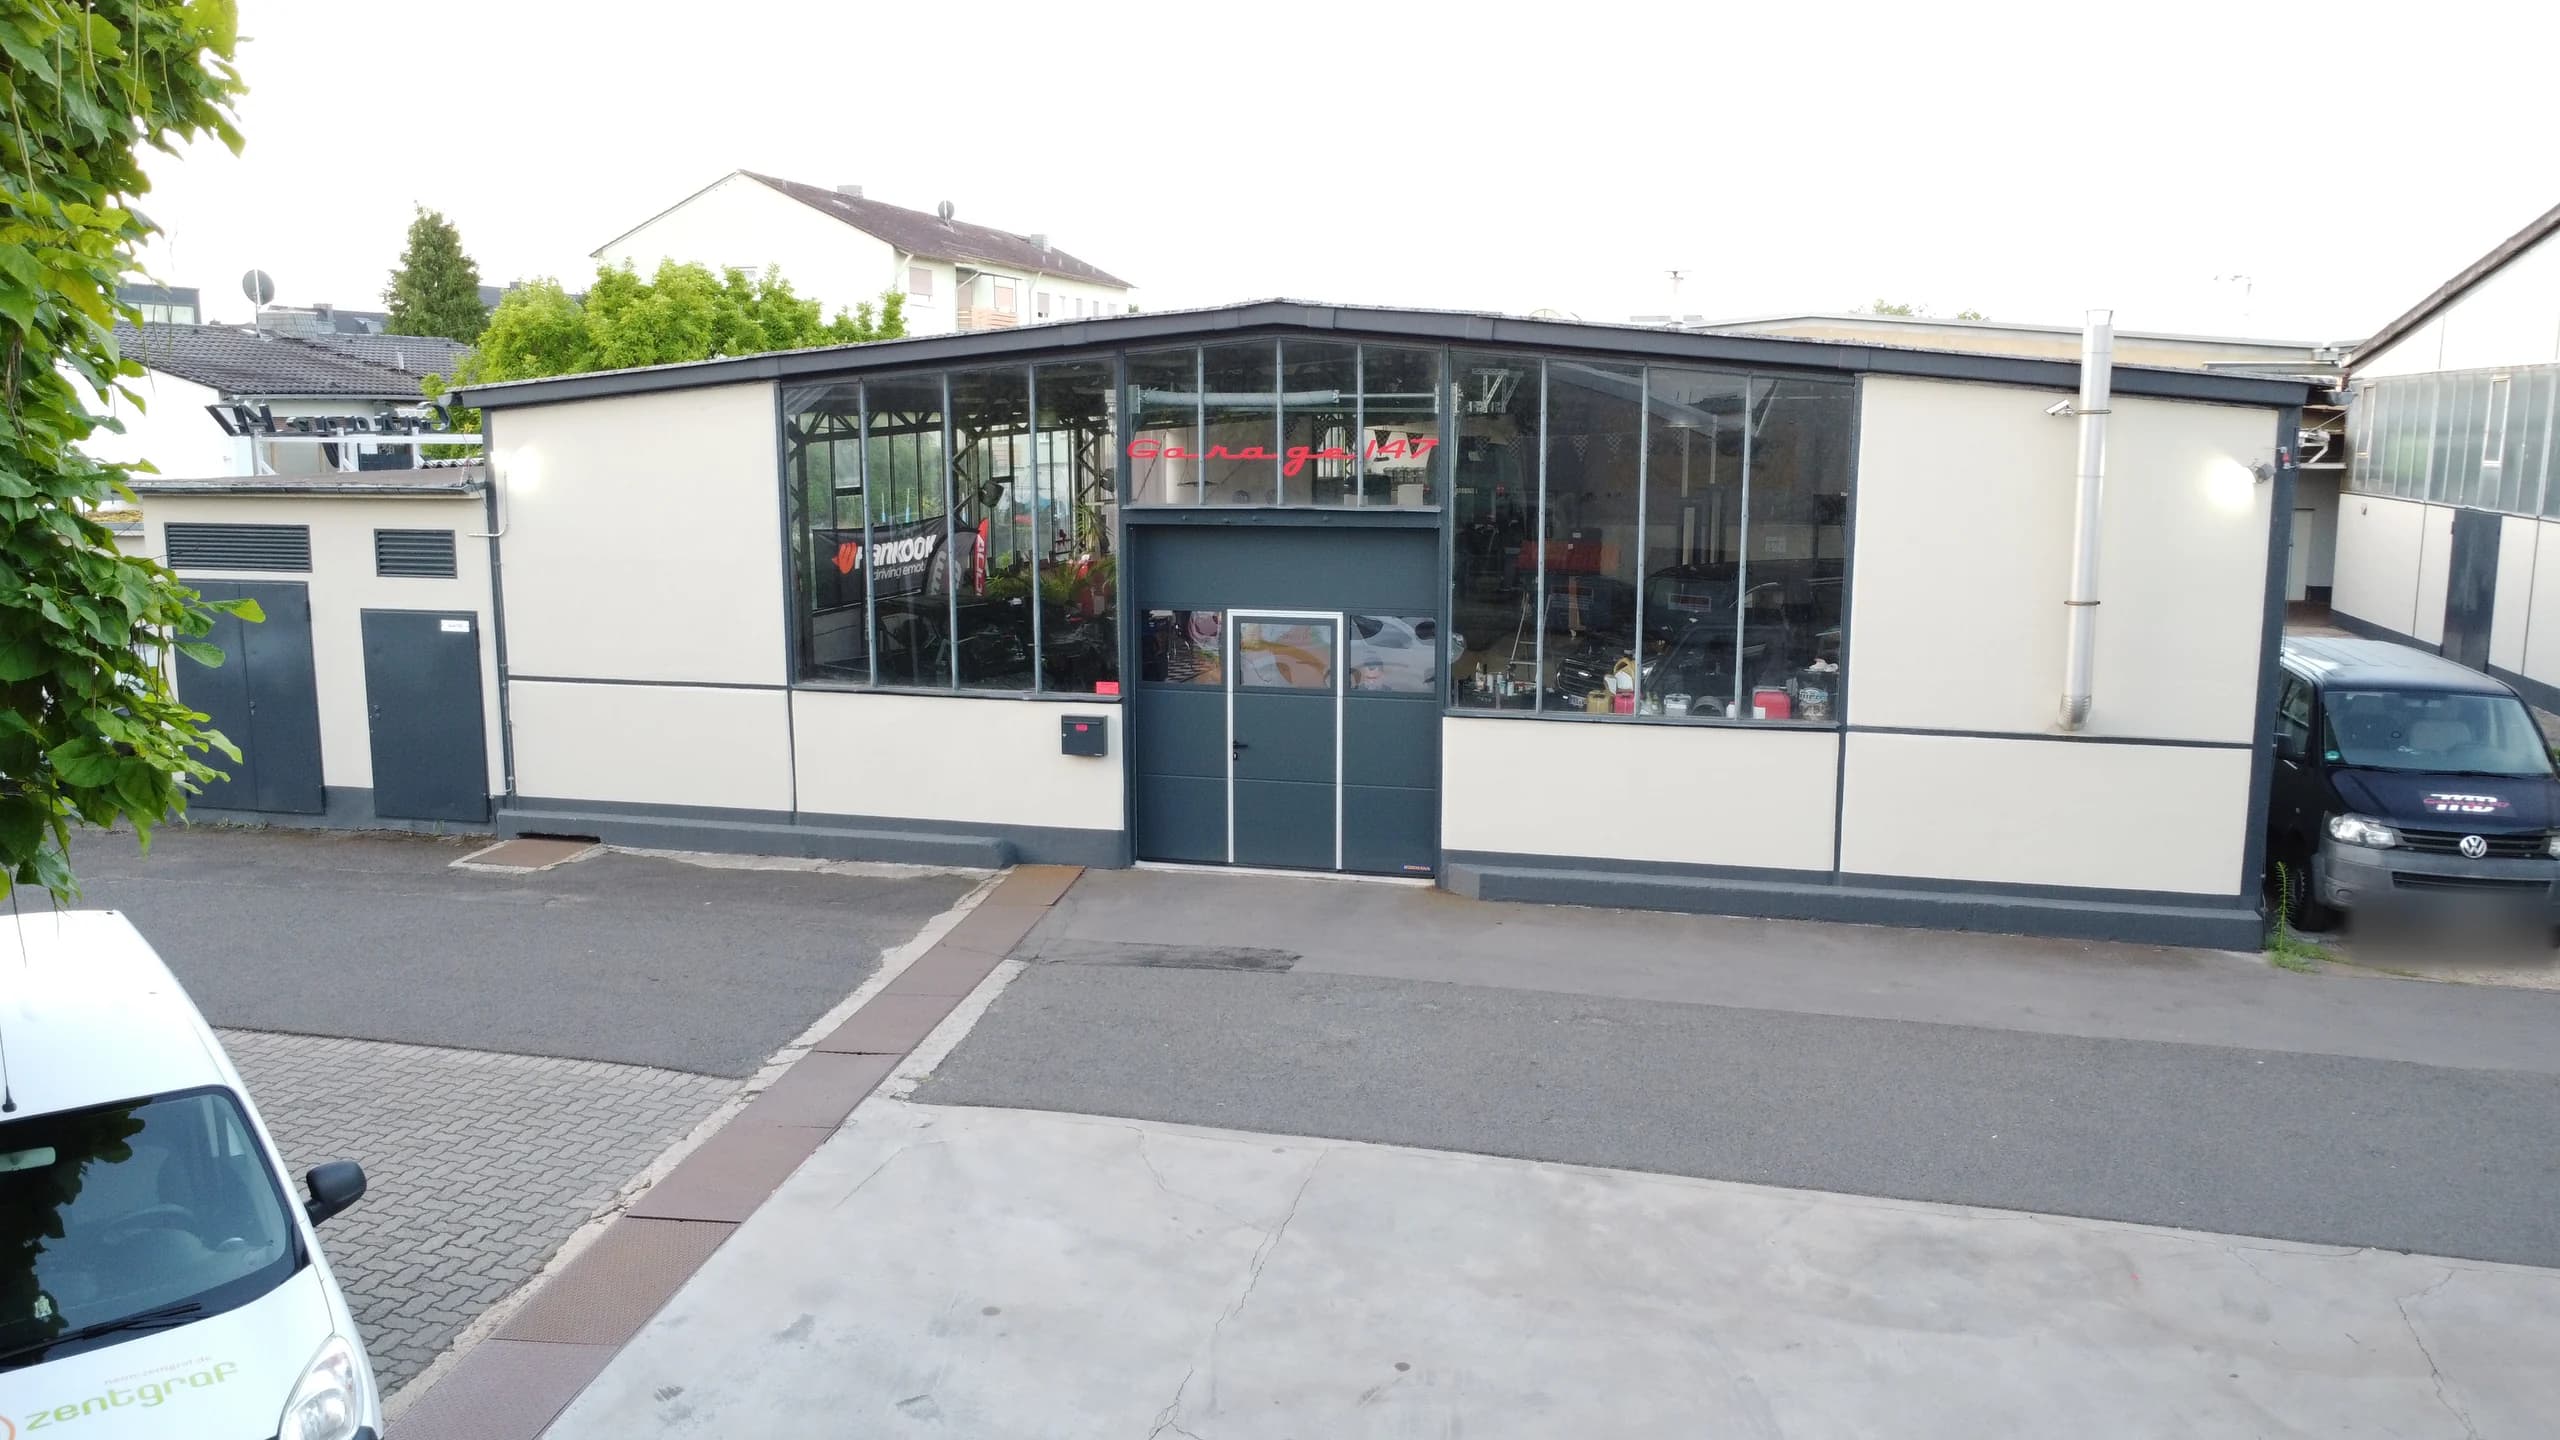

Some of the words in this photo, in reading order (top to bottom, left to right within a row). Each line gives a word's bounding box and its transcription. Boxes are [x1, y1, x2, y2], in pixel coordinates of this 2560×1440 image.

[1127, 439, 1355, 476] Garage
[1364, 438, 1440, 460] 147
[24, 1361, 239, 1431] zentgraf
